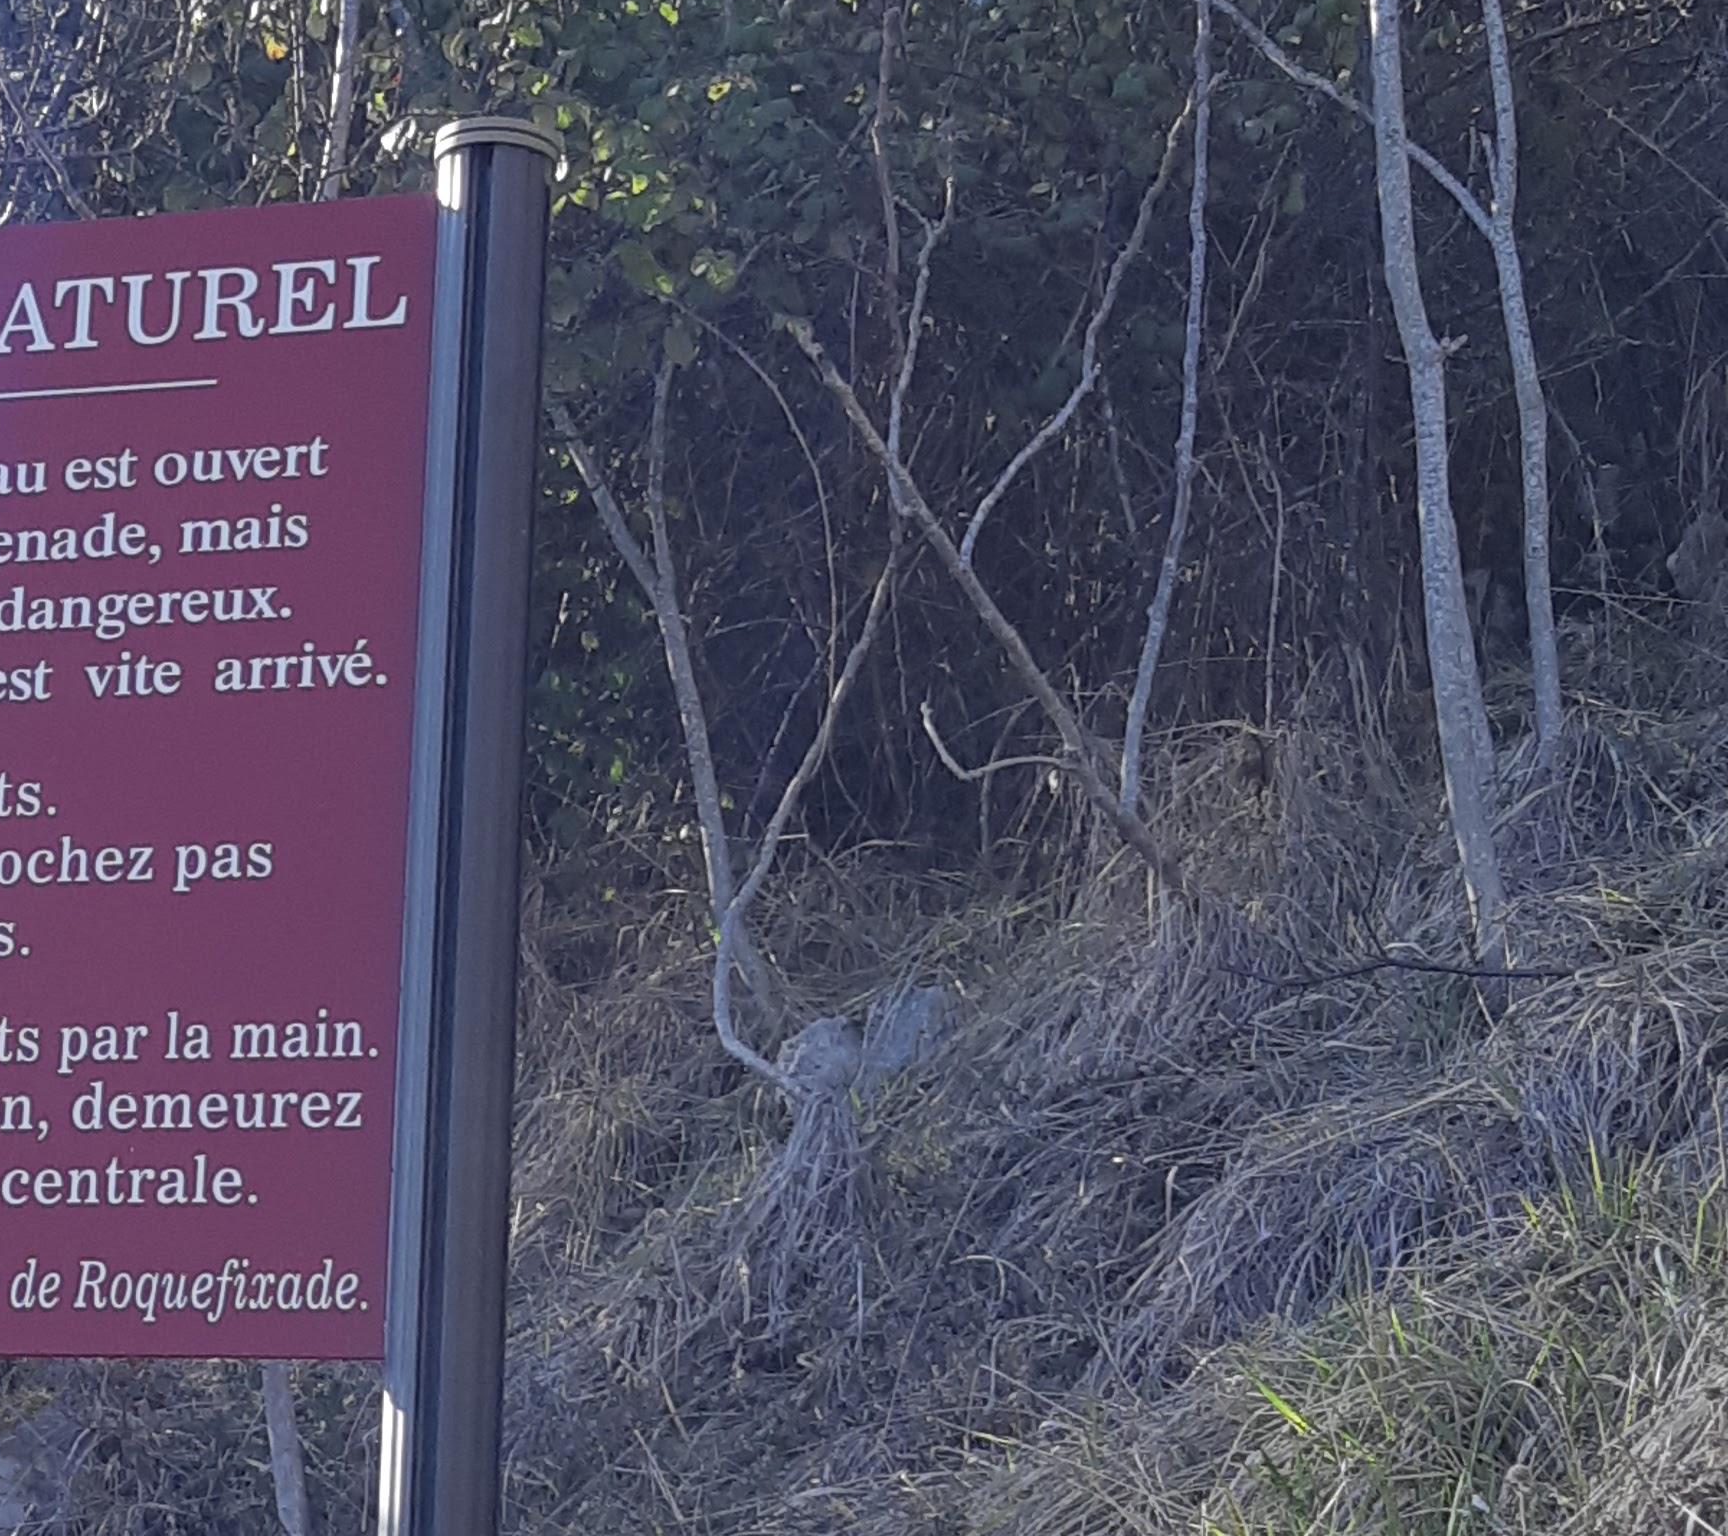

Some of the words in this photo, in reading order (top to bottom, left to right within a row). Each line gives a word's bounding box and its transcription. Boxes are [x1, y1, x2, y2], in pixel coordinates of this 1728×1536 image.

[63, 447, 140, 492] est
[153, 435, 331, 487] ouvert
[177, 502, 310, 554] mais
[83, 650, 183, 699] vite
[213, 637, 389, 693] arrivé.
[171, 841, 274, 893] pas
[56, 1024, 150, 1075] par
[163, 1010, 212, 1061] la
[228, 1007, 380, 1060] main.
[71, 1079, 364, 1131] demeurez
[0, 1153, 259, 1206] centrale.
[9, 1257, 62, 1310] de
[72, 1257, 369, 1324] Roquefixade.
